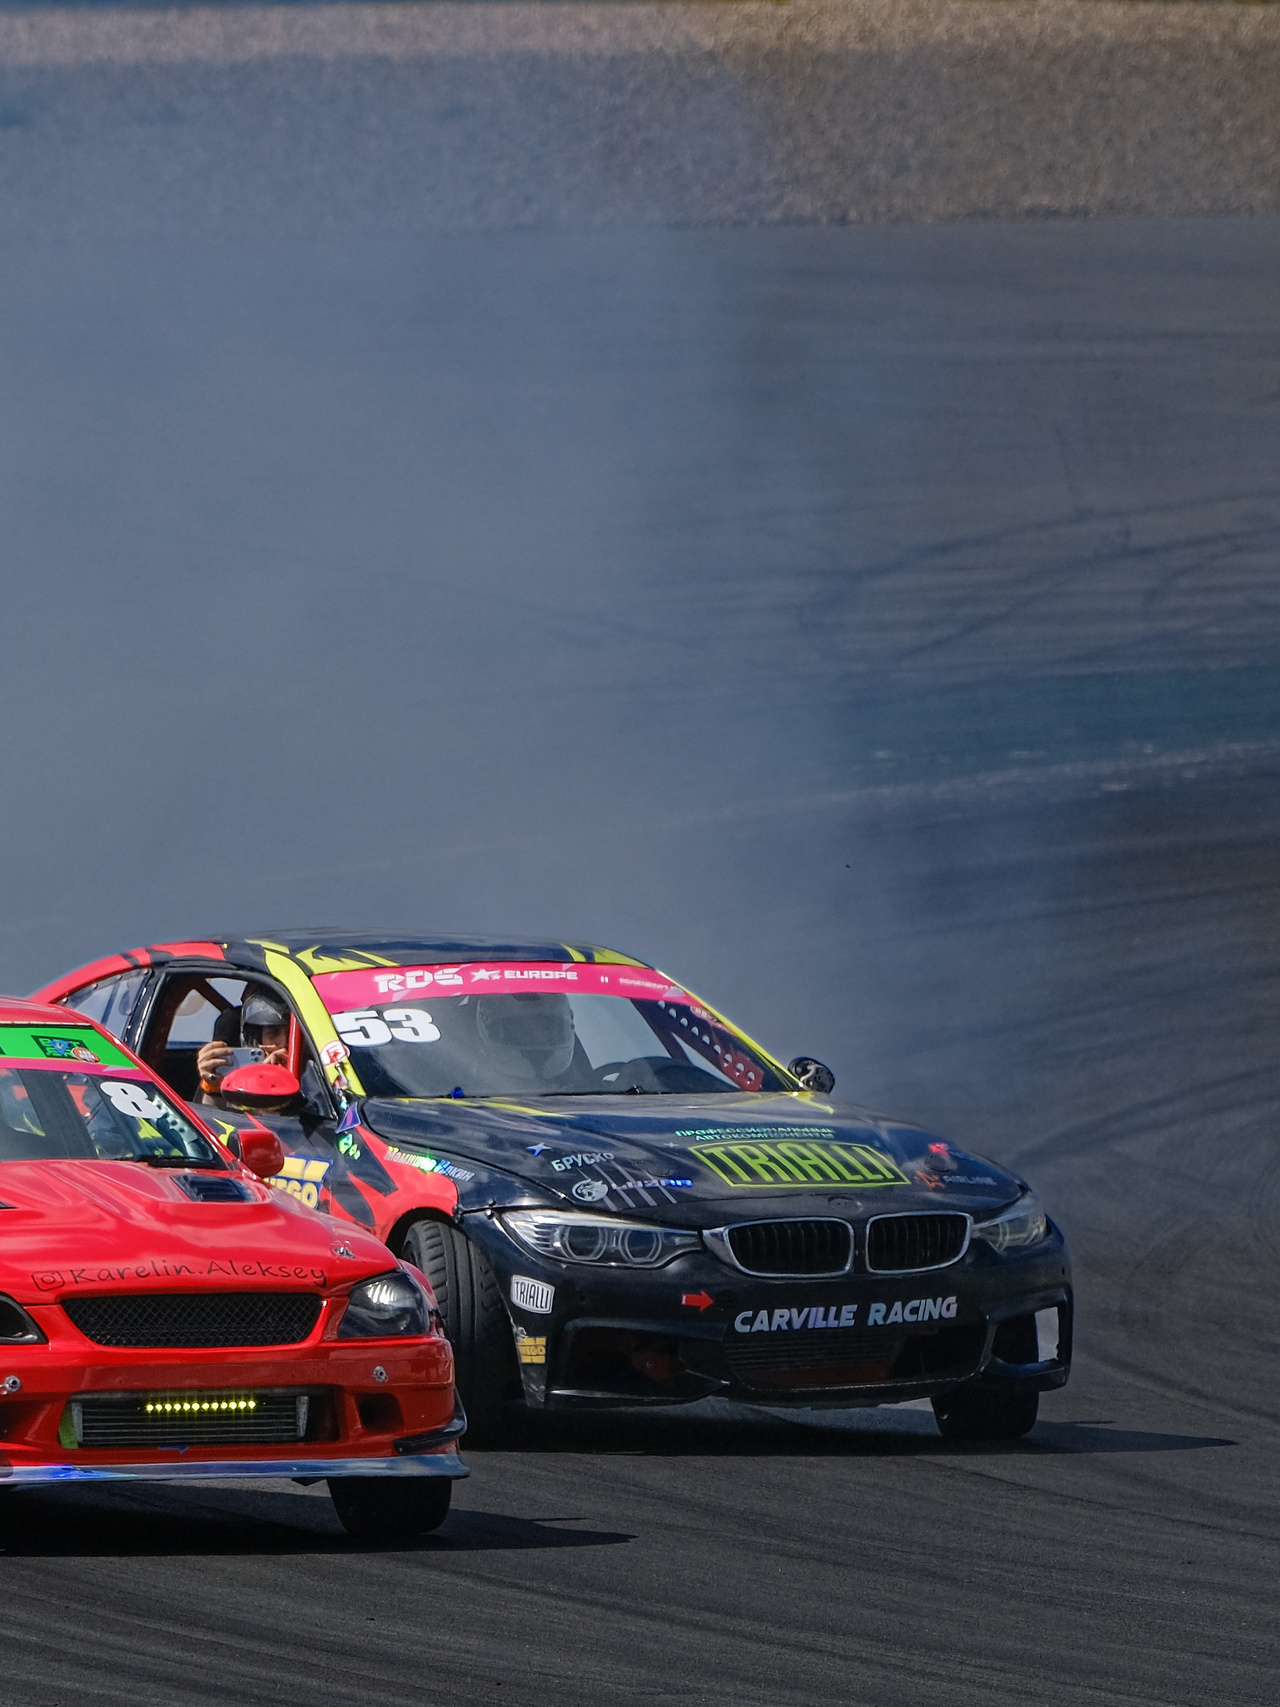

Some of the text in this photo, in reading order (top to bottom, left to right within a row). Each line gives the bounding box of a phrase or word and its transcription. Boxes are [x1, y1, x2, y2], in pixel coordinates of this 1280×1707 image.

[374, 967, 578, 993] RDS EUROPE
[331, 1008, 441, 1047] 53
[100, 1081, 163, 1119] 8
[551, 1151, 616, 1172] БРУСКО
[702, 1142, 896, 1182] TRIALLI
[264, 1177, 318, 1209] EGO
[70, 1260, 327, 1287] Karelin.Aleksey
[515, 1281, 549, 1309] TRIALLI
[734, 1296, 957, 1334] CARVILLE RACING
